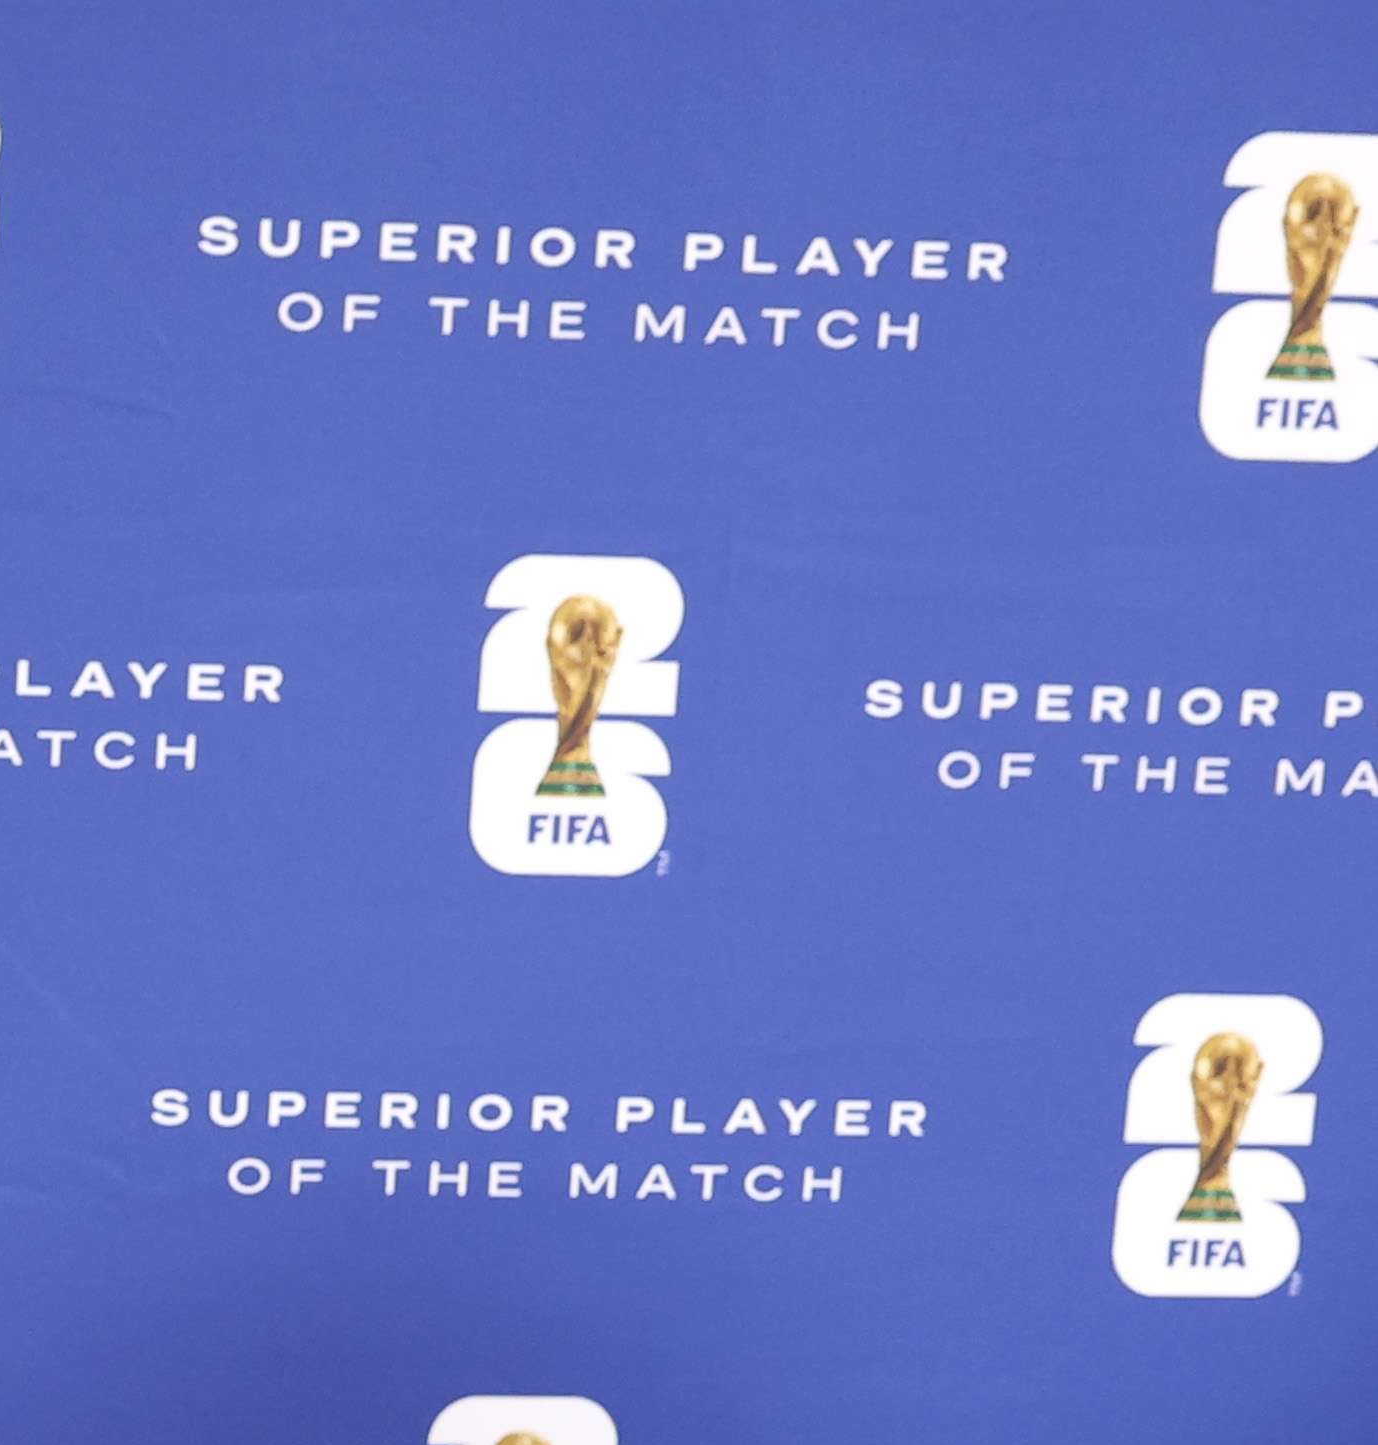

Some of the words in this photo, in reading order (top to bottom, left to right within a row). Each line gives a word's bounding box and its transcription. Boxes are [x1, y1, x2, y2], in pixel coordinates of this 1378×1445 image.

[197, 215, 636, 270] SUPERIOR
[683, 232, 1008, 283] PLAYER
[277, 291, 381, 333] OF
[428, 296, 587, 341] THE
[634, 303, 920, 351] MATCH
[1257, 398, 1338, 429] FIFA
[864, 679, 1280, 727] SUPERIOR
[937, 750, 1036, 790] OF
[1081, 754, 1231, 795] THE
[528, 814, 610, 845] FIFA
[150, 1088, 570, 1132] SUPERIOR
[615, 1096, 927, 1138] PLAYER
[227, 1157, 326, 1195] OF
[371, 1159, 523, 1198] THE
[569, 1162, 843, 1203] MATCH
[1167, 1239, 1246, 1268] FIFA
